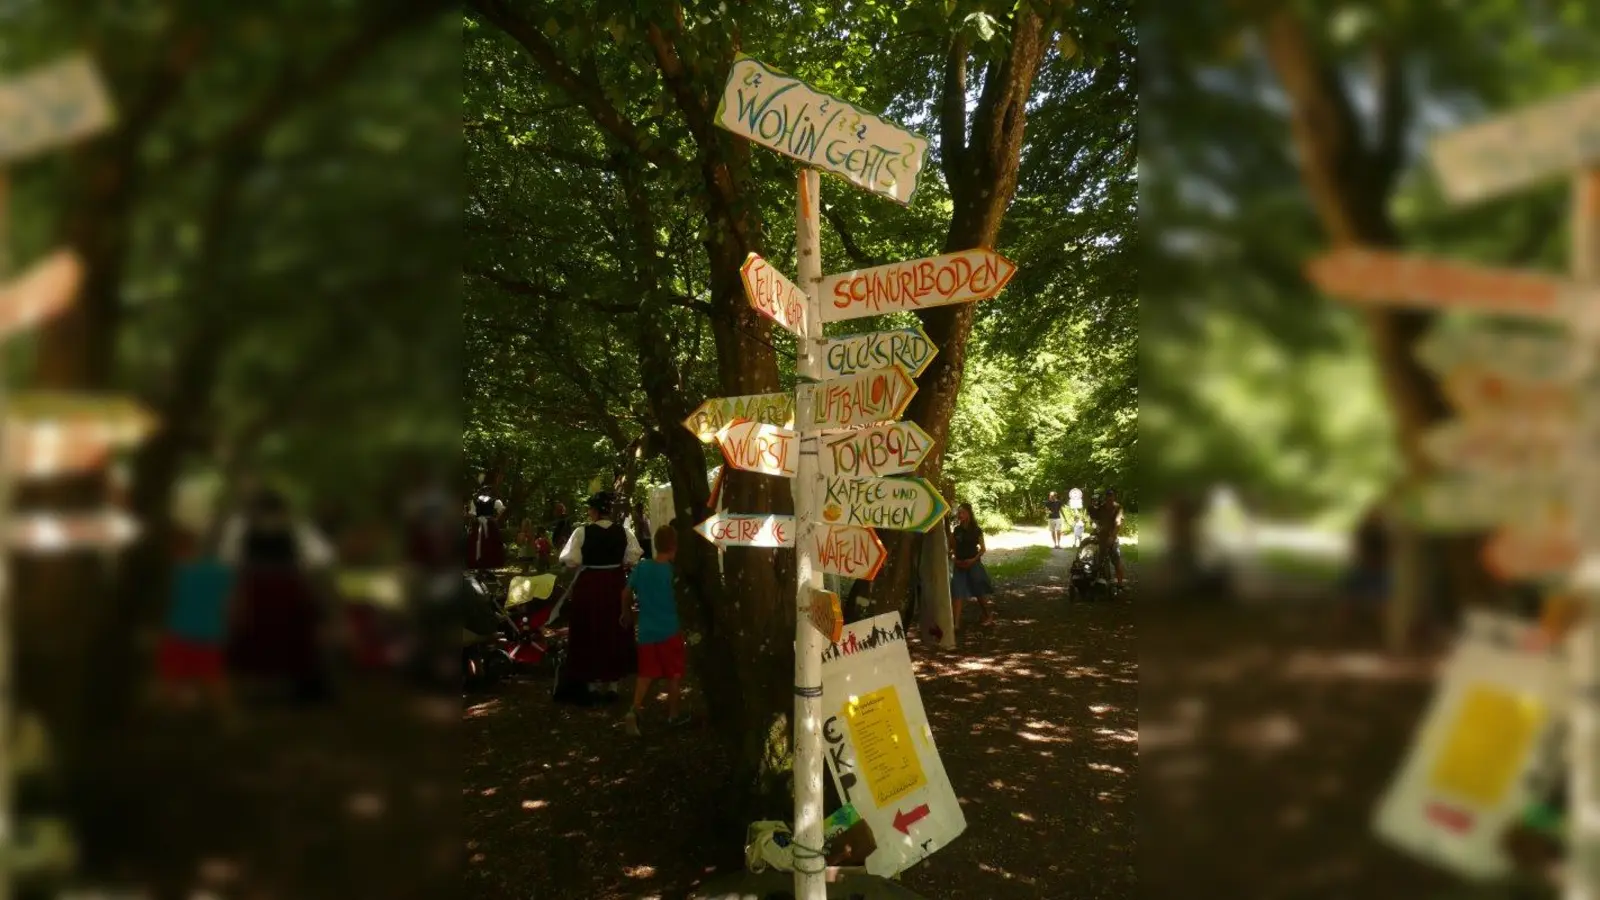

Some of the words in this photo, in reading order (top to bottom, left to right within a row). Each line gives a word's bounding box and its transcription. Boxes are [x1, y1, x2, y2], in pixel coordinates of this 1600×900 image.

[833, 254, 999, 311] SCHNÜRLBODEN
[814, 373, 897, 424] LUFTBALLON
[826, 427, 922, 476] TOMBOLA
[825, 476, 888, 505] KAFFEE
[892, 487, 918, 500] UND
[848, 502, 914, 526] KUCHEN
[711, 517, 790, 544] GETRÄKE
[815, 525, 870, 574] WAFFELN
